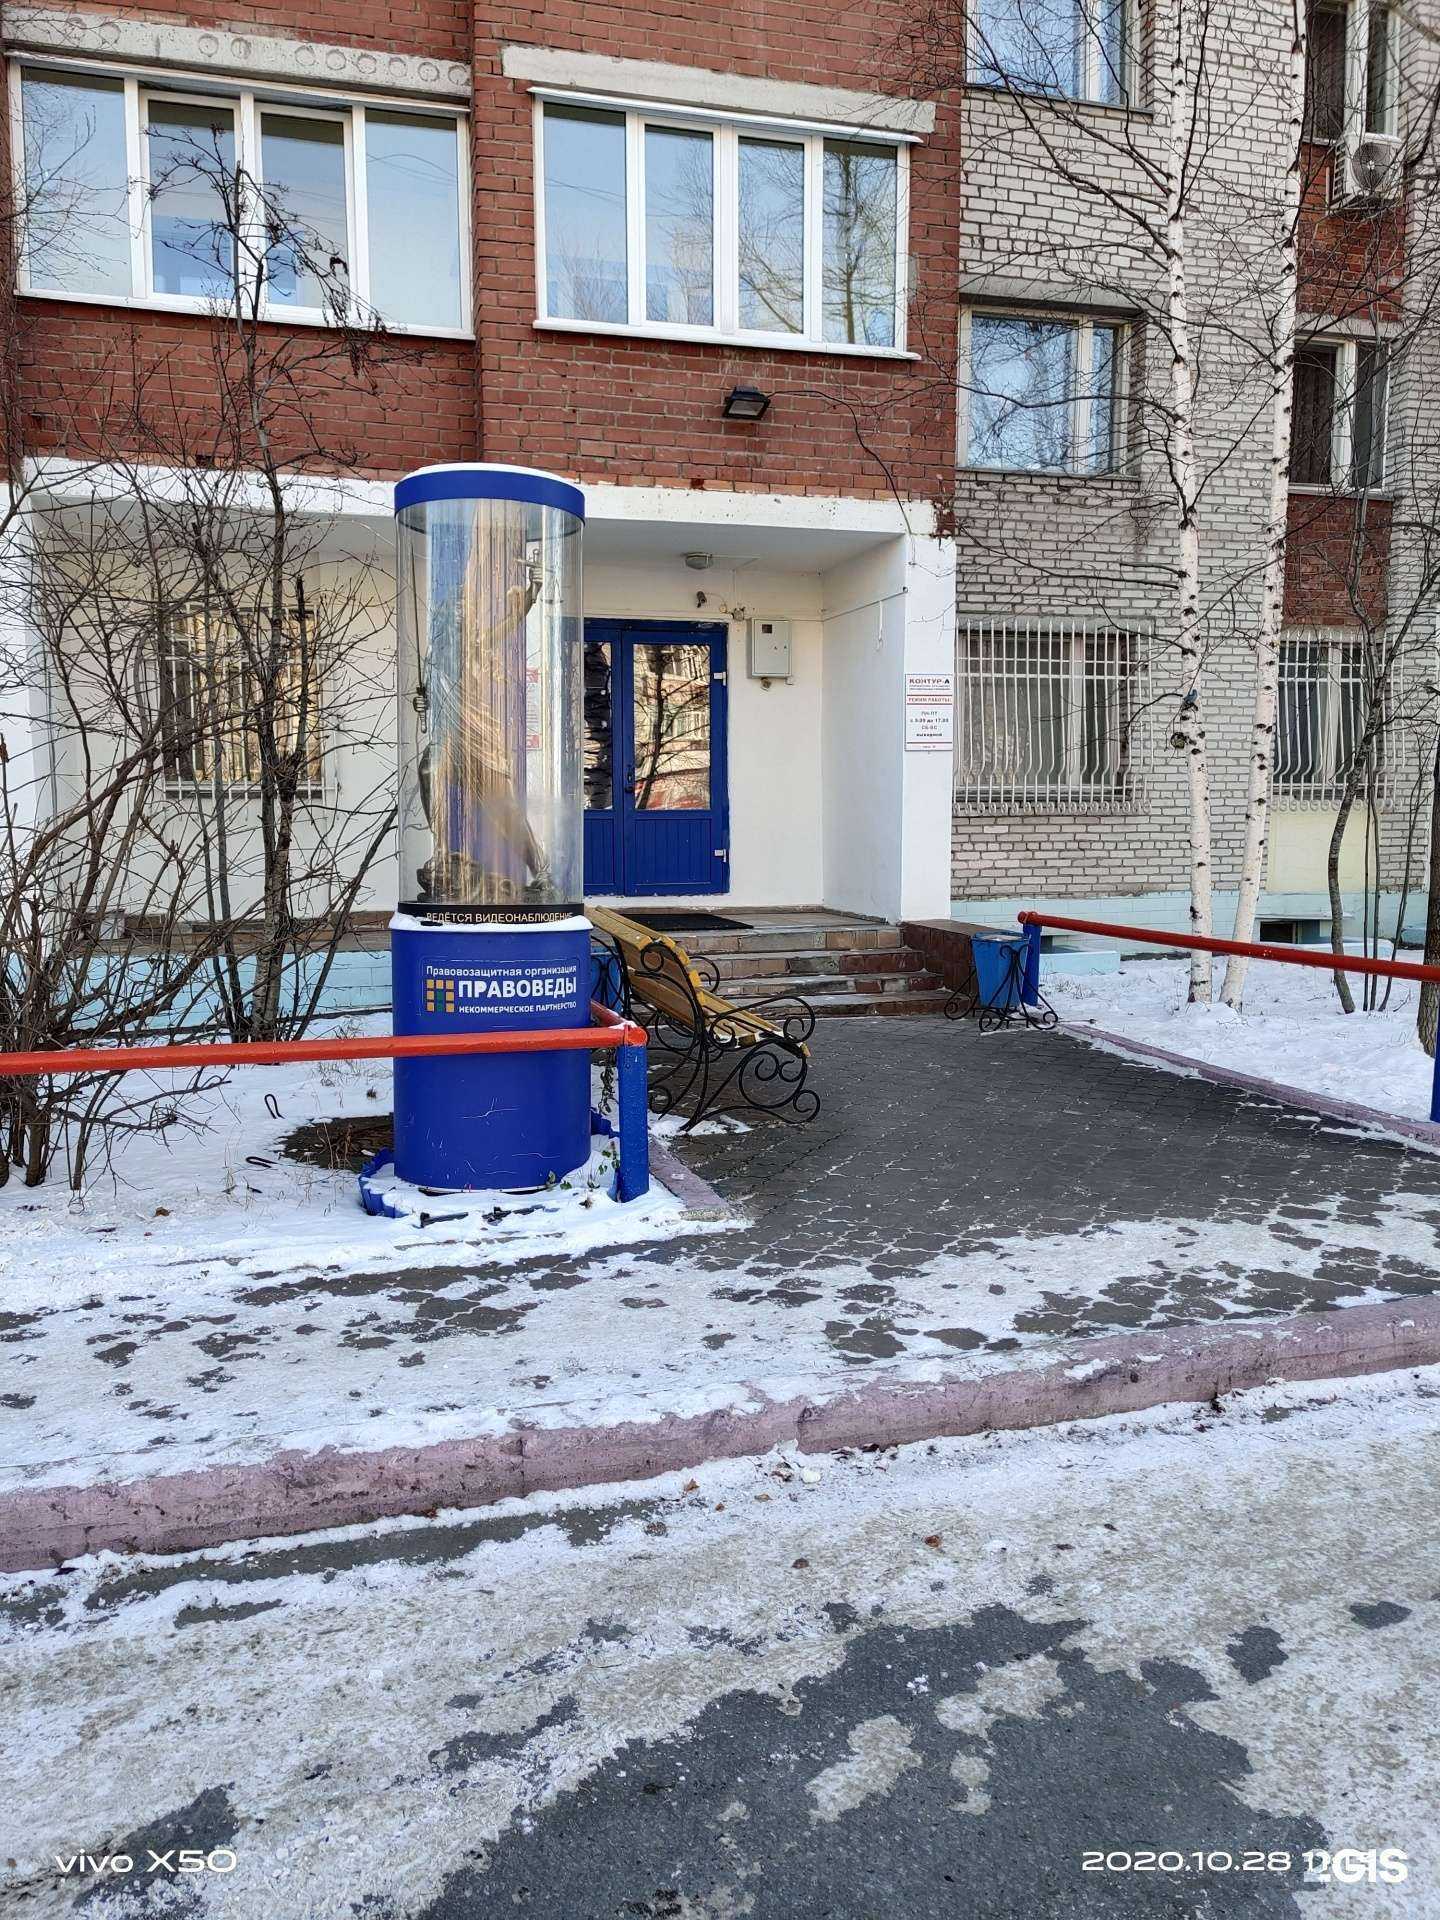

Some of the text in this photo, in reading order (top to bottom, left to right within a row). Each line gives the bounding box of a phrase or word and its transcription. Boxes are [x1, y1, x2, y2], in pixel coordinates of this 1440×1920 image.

[426, 965, 577, 977] Правовозащитная организация
[458, 977, 577, 998] ПРАВОВЕДЫ
[459, 1001, 577, 1014] НЕКОММЕРЧЕСКОЕ ПАРТНЕРСТВО
